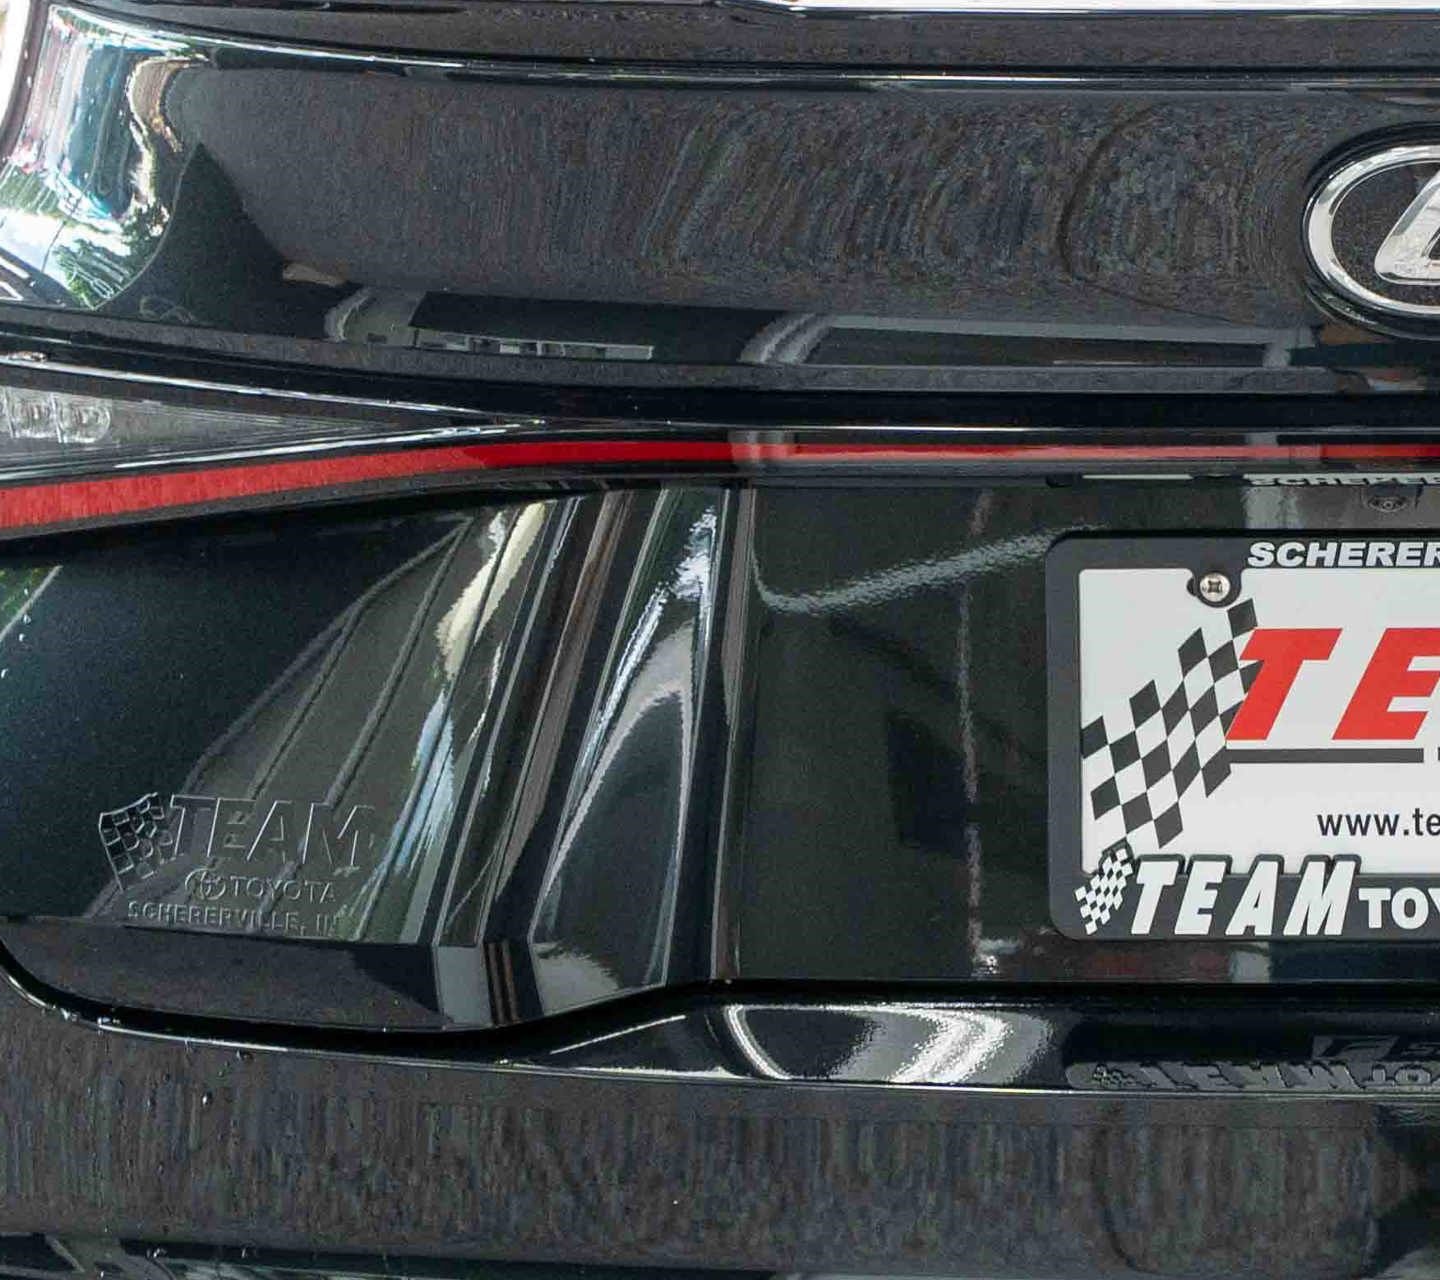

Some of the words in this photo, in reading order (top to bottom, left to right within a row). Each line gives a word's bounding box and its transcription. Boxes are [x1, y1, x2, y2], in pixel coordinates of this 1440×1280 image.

[171, 793, 375, 877] TEAM
[231, 877, 336, 905] TOYOTA
[128, 901, 306, 934] SCHERERVILLE,
